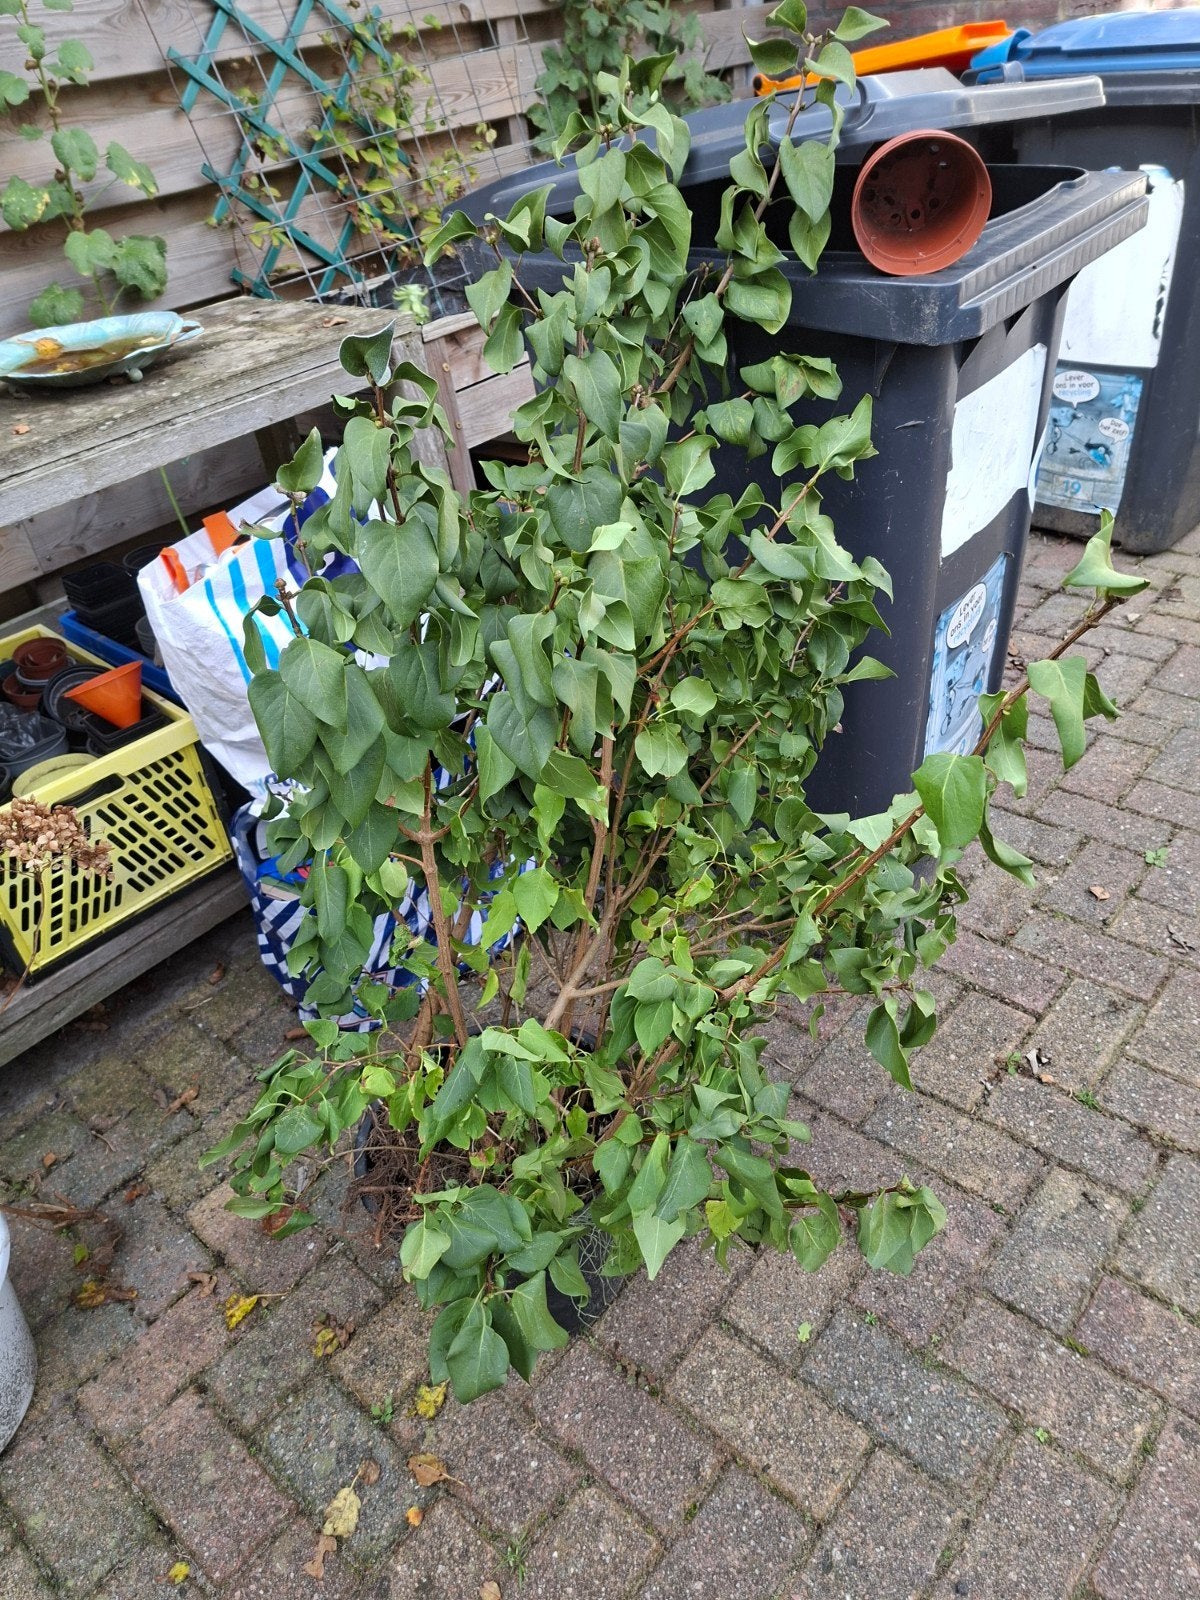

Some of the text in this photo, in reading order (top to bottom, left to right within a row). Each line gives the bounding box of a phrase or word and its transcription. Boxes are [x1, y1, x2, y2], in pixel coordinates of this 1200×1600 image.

[1064, 374, 1086, 382] Lever
[1062, 479, 1082, 496] 19
[959, 591, 977, 617] Lever
[950, 620, 962, 637] ons
